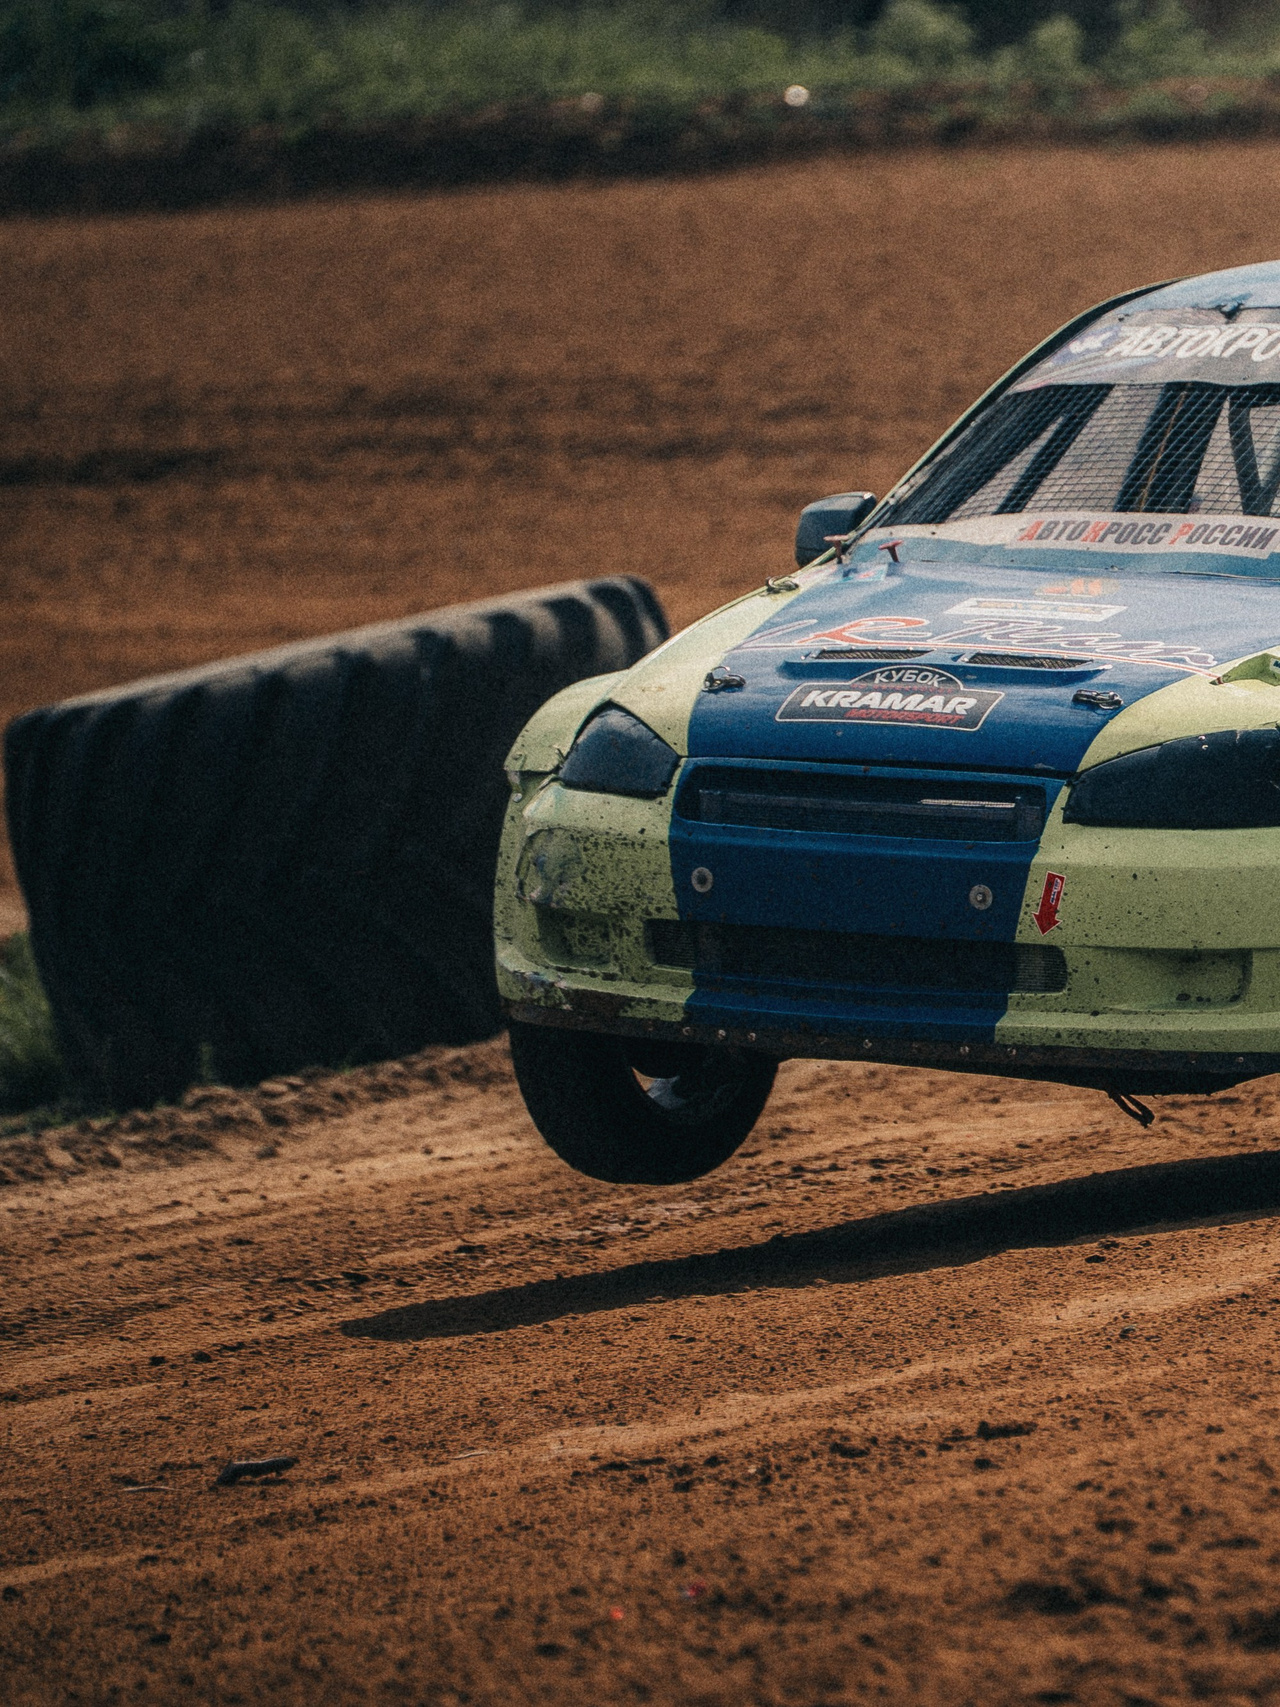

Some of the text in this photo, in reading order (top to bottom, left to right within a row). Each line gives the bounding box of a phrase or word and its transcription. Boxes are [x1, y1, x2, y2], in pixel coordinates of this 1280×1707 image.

[873, 668, 947, 688] КУБОК
[799, 689, 979, 716] KRAMAR
[843, 708, 965, 726] MOTORSPORT
